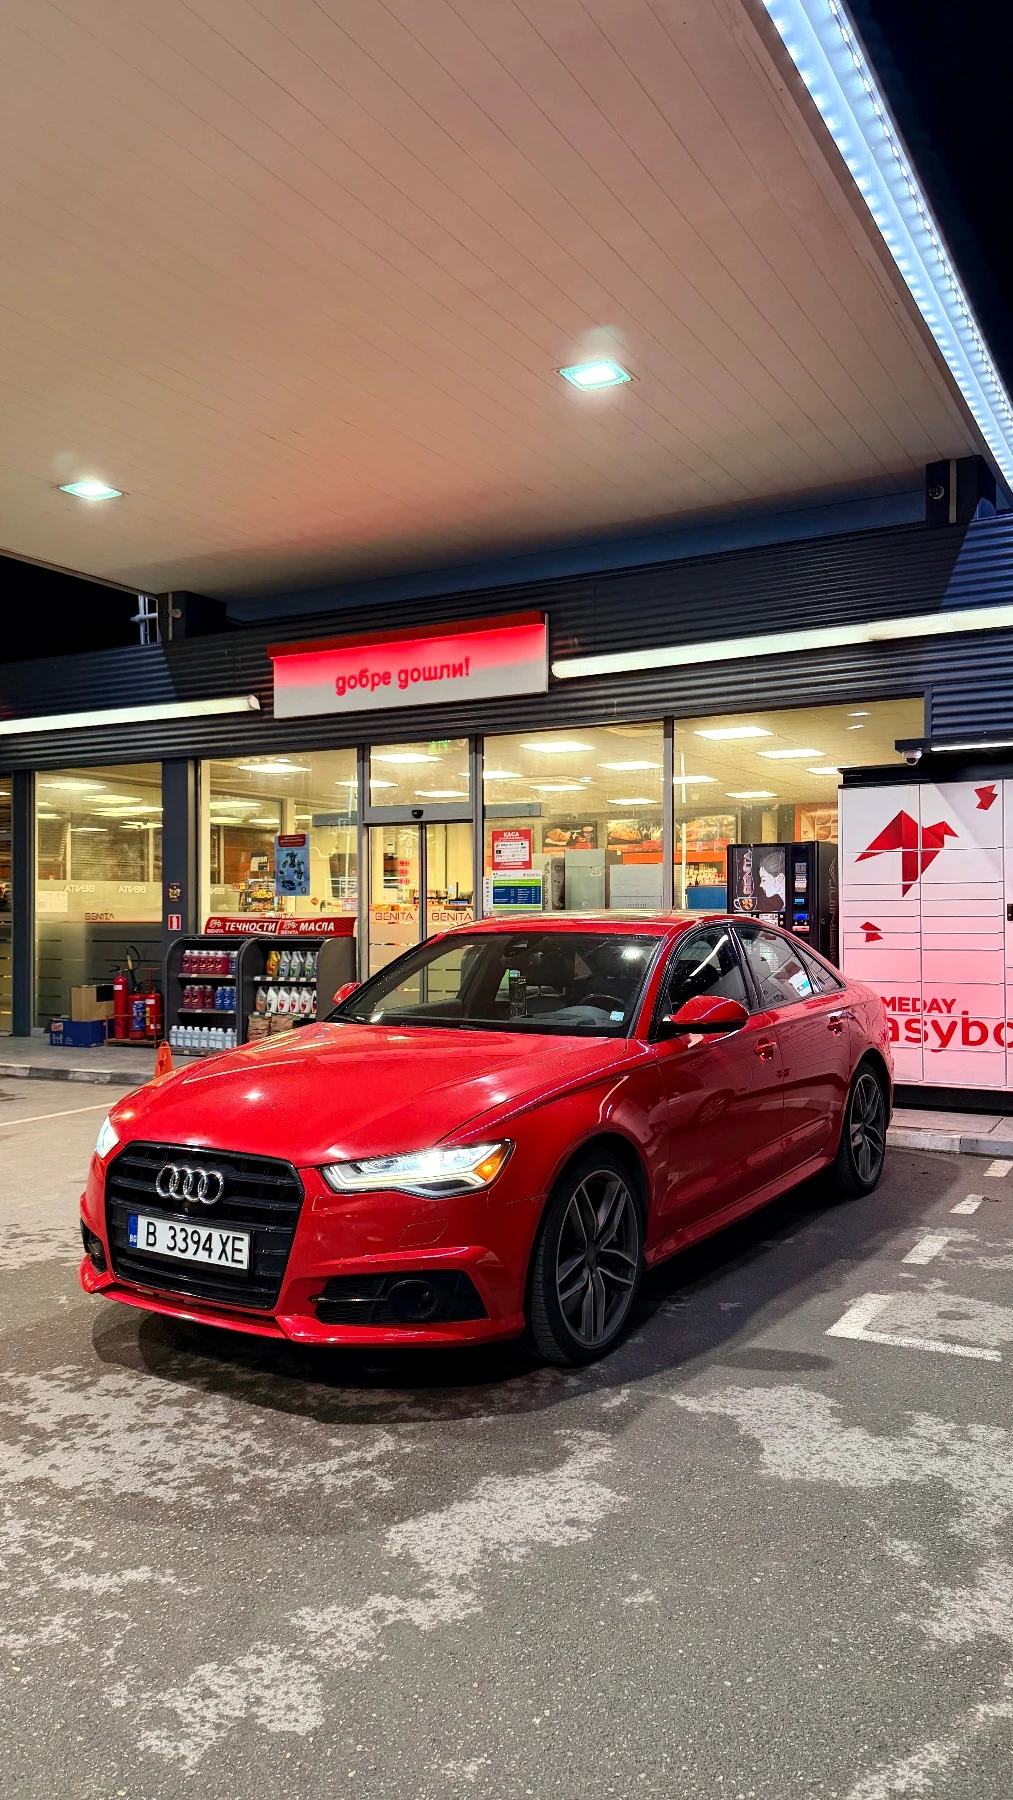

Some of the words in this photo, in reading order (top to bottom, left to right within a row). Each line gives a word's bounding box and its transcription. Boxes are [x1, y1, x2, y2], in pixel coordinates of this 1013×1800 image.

[335, 668, 392, 696] добре
[397, 656, 471, 690] дошли!
[84, 912, 115, 921] BENITA
[375, 912, 414, 921] BENITA
[431, 912, 473, 921] BENITA
[225, 922, 277, 932] ТЕЧНОСТИ
[299, 921, 335, 932] МАСЛА
[880, 996, 957, 1014] MEDAY
[886, 1010, 1013, 1053] asybo
[129, 1233, 138, 1243] BG
[145, 1220, 157, 1247] B
[166, 1225, 213, 1259] 3394
[218, 1233, 245, 1265] XE
